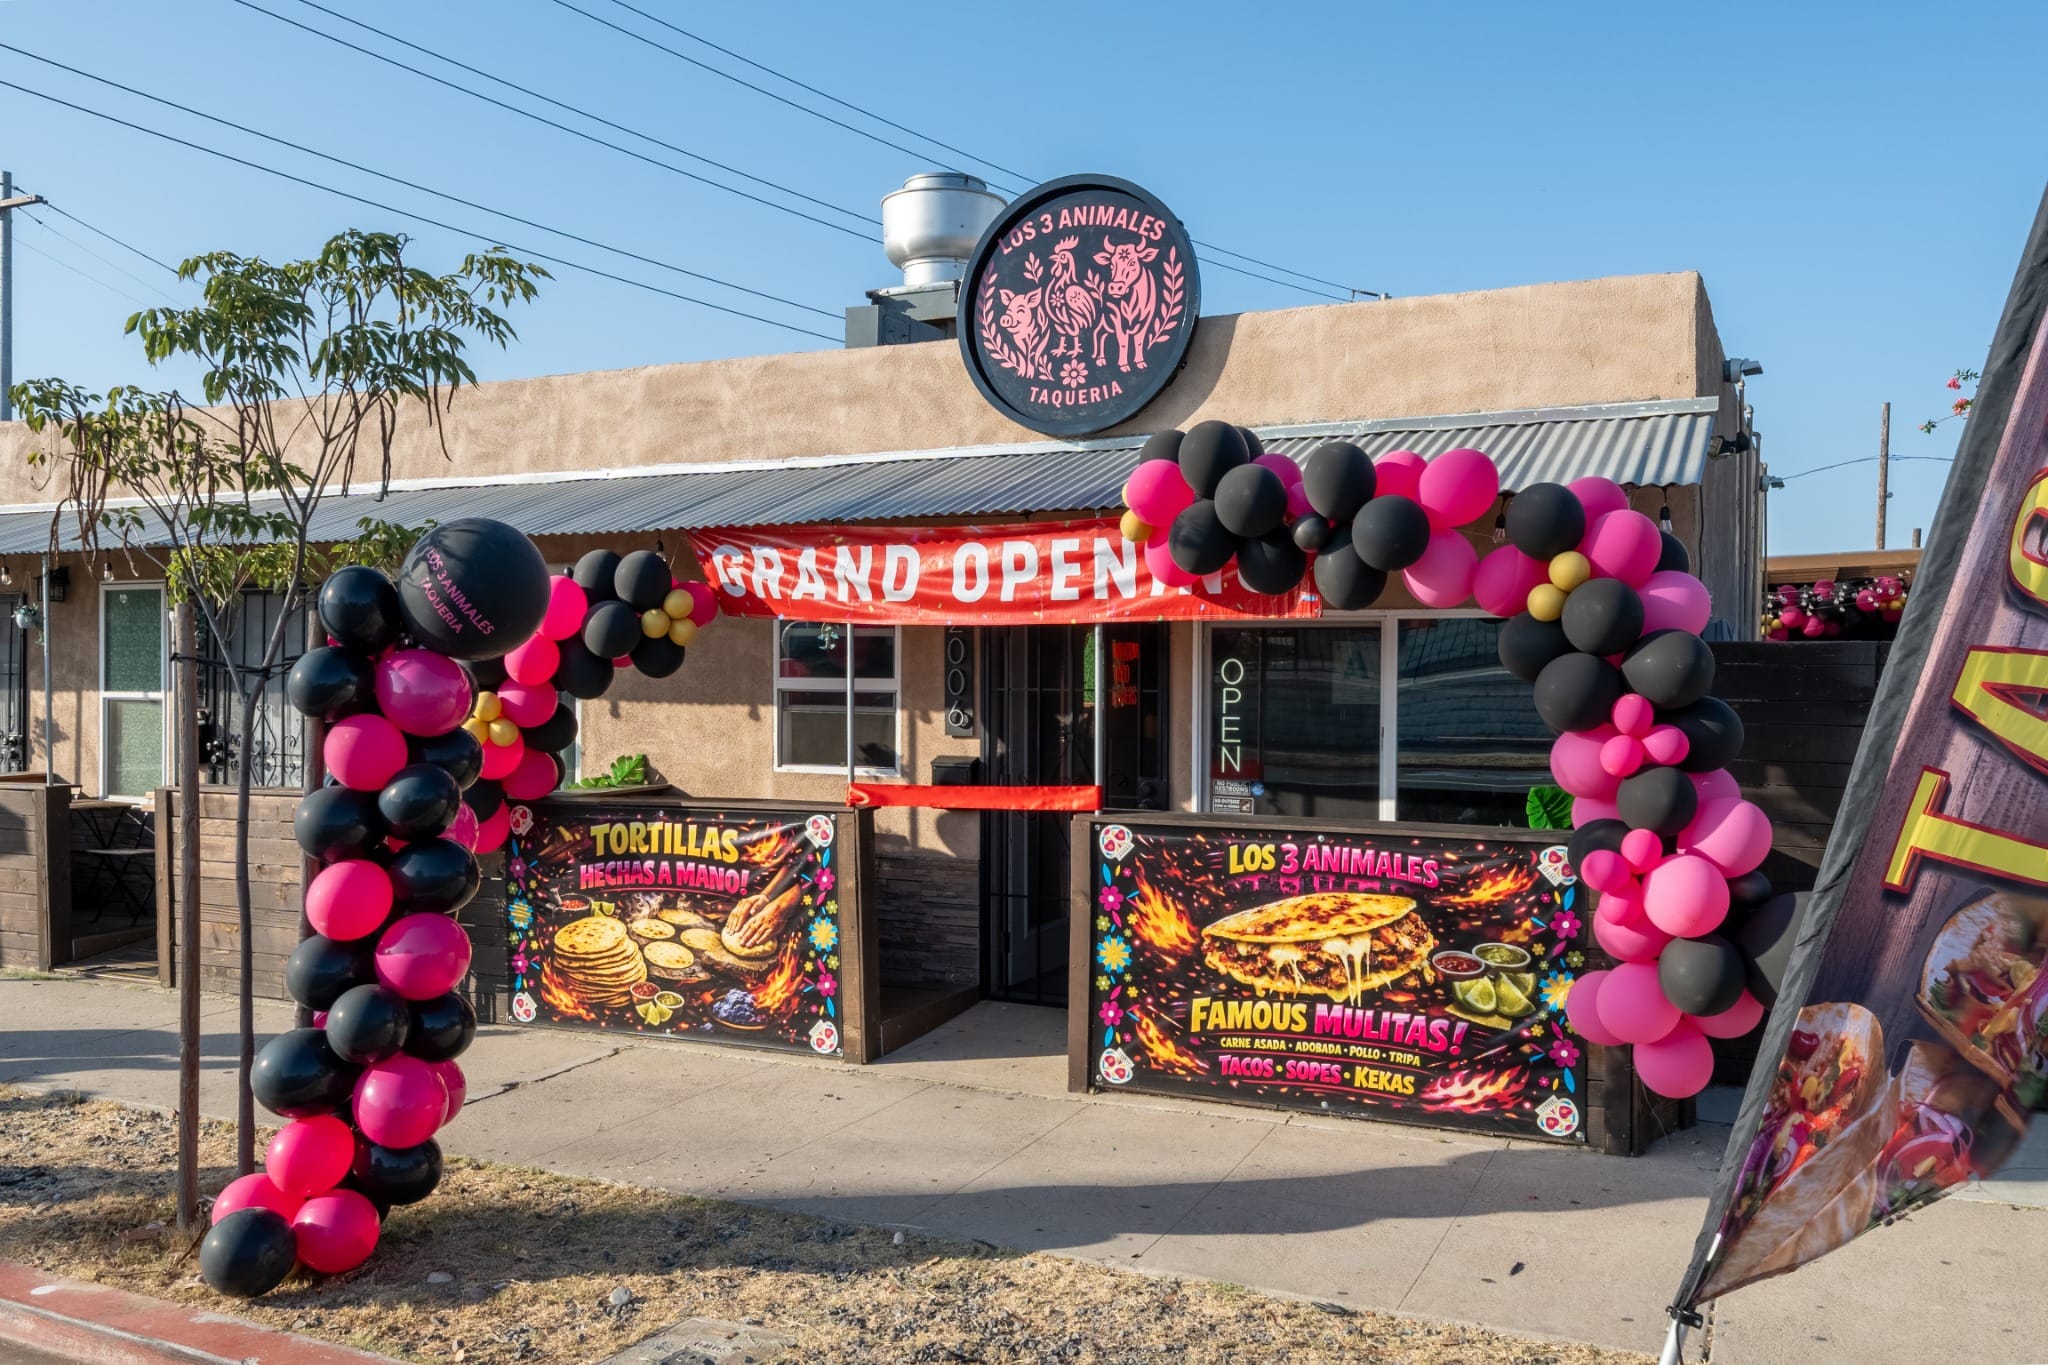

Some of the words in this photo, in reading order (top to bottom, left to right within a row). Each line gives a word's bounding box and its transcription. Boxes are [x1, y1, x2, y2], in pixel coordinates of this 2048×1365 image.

[998, 220, 1036, 255] LOS
[1041, 213, 1053, 234] 3
[1059, 205, 1167, 241] ANIMALES
[1030, 381, 1123, 408] TAQUERIA
[426, 546, 444, 571] LOS
[437, 570, 448, 581] 3
[712, 544, 921, 602] GRAND
[952, 537, 1260, 602] OPEN
[419, 576, 463, 634] TAQUERIA
[441, 579, 496, 636] ANIMALES
[1221, 658, 1244, 773] OPEN
[590, 822, 741, 863] TORTILLAS
[580, 860, 655, 890] HECHAS
[658, 867, 673, 885] A
[676, 861, 750, 895] MANO!
[1228, 843, 1276, 874] LOS
[1280, 843, 1299, 874] 3
[1302, 844, 1440, 889] ANIMALES
[1190, 997, 1308, 1033] FAMOUS
[1314, 1003, 1470, 1055] MULITAS!
[1220, 1037, 1251, 1049] CARNE
[1254, 1038, 1286, 1051] ASADA
[1295, 1041, 1342, 1056] ADOBADA
[1349, 1046, 1380, 1061] POLLO
[1388, 1051, 1422, 1067] TRIPA
[1218, 1055, 1274, 1077] TACOS
[1285, 1059, 1342, 1084] SOPES
[1354, 1066, 1415, 1095] KEKAS
